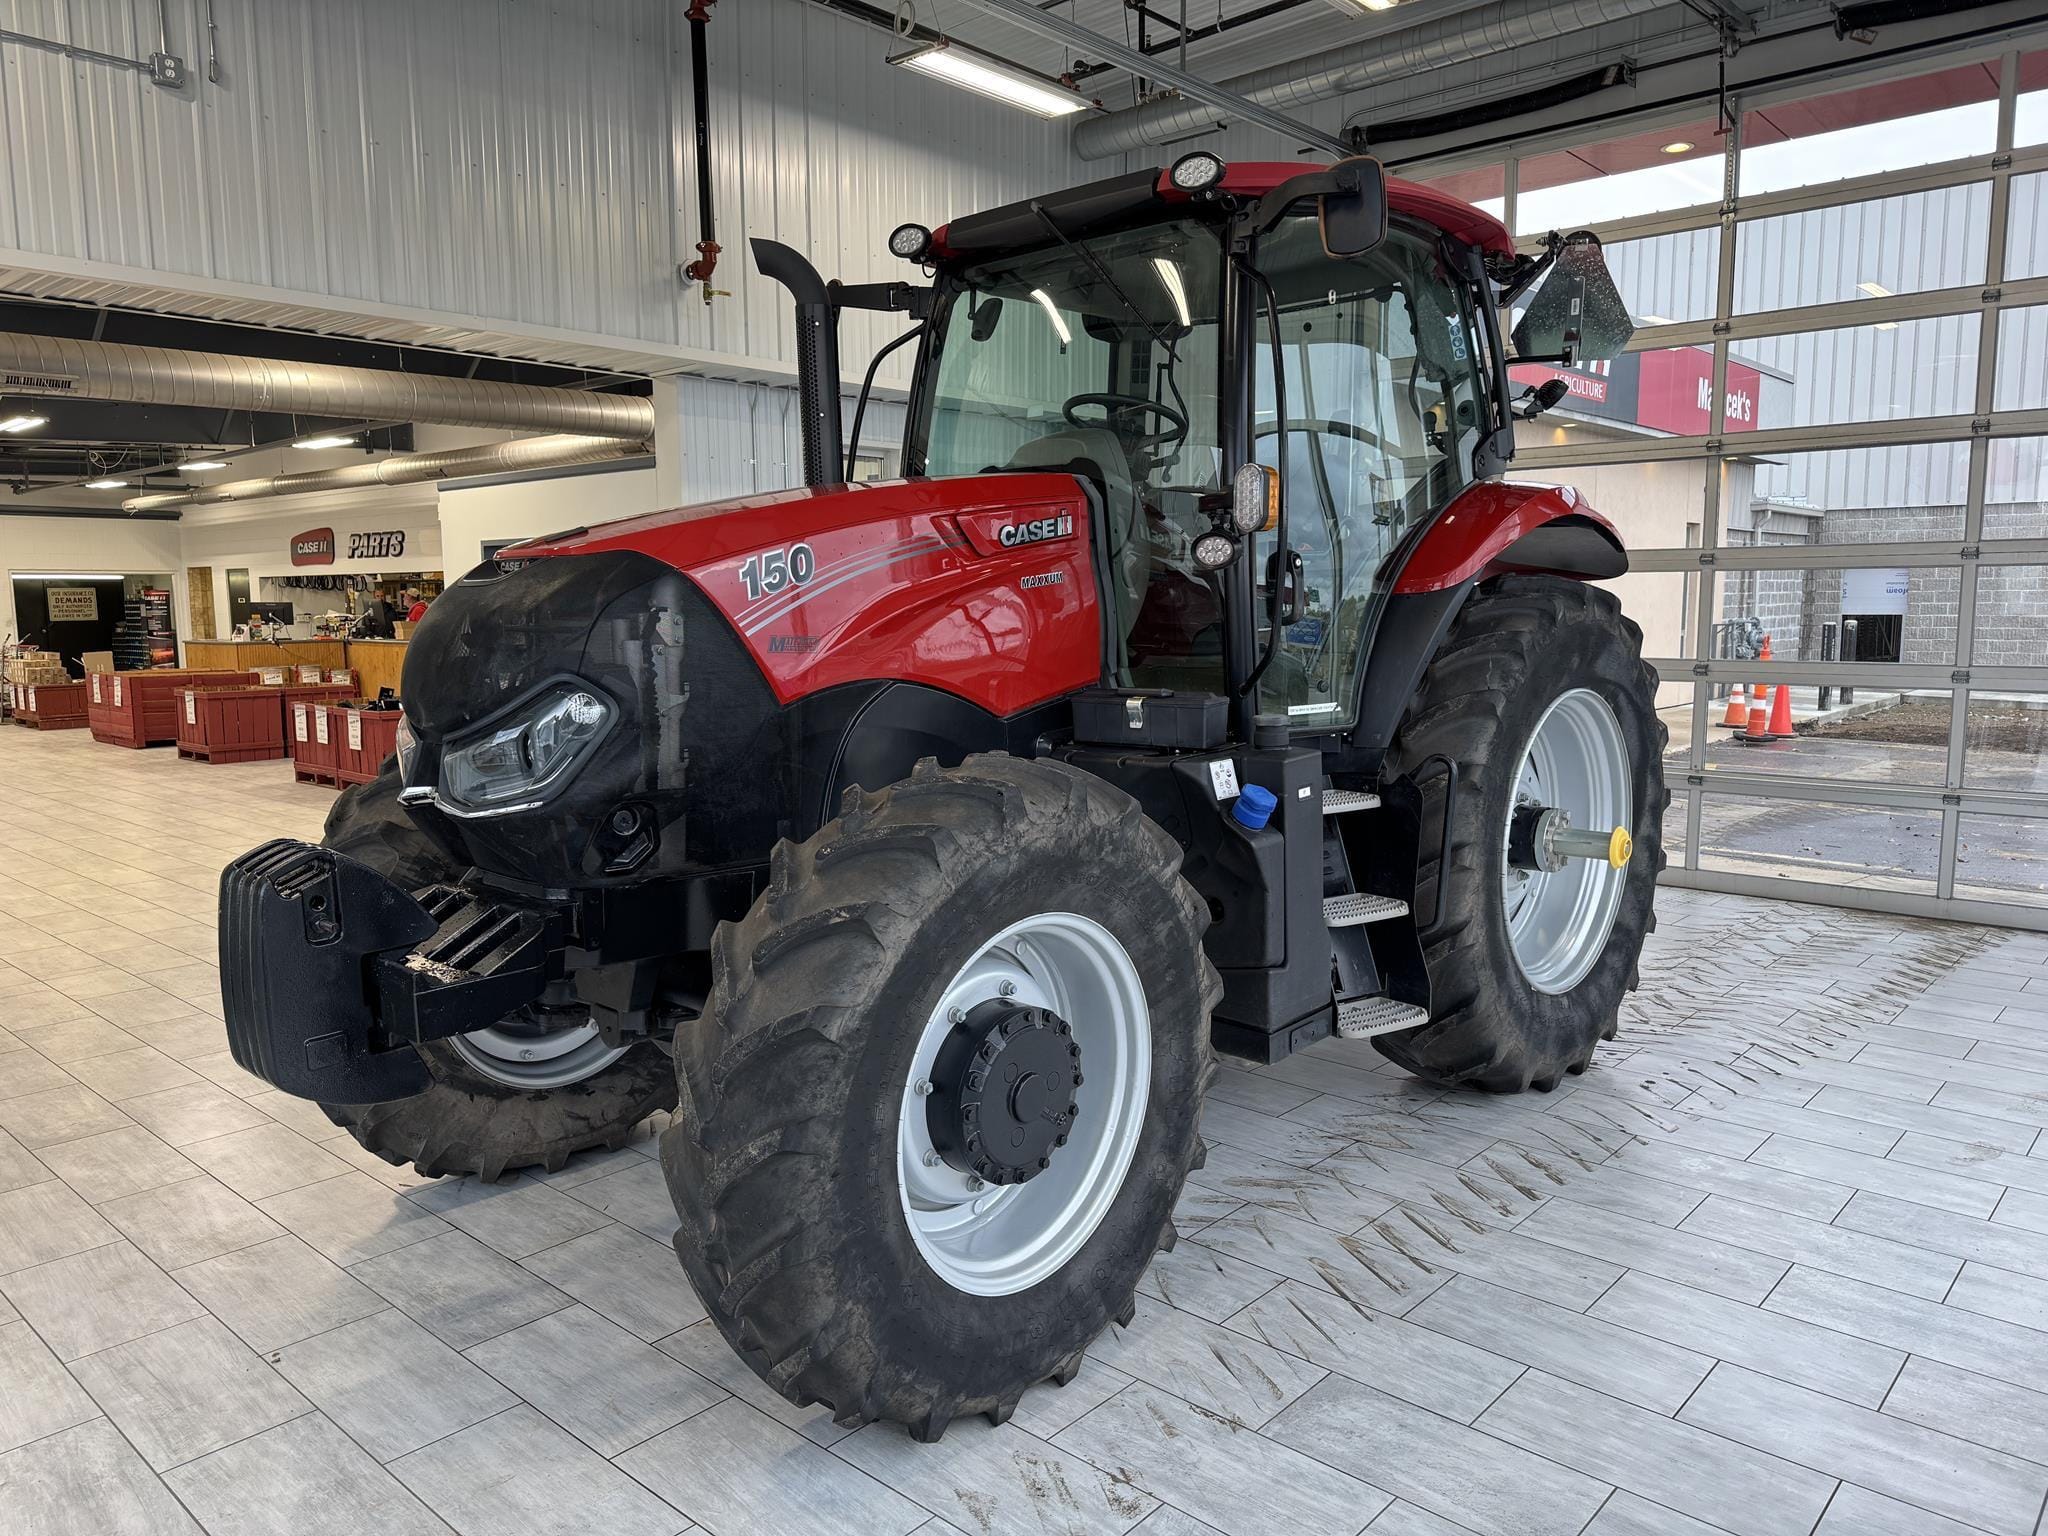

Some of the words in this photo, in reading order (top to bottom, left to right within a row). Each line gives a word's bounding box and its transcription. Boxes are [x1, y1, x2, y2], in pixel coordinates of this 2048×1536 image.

[1000, 518, 1055, 547] CASE
[297, 541, 319, 554] CASE
[347, 530, 406, 559] PARTS
[500, 561, 520, 571] CASE
[739, 542, 815, 601] 150
[1020, 571, 1064, 589] MAXXUM
